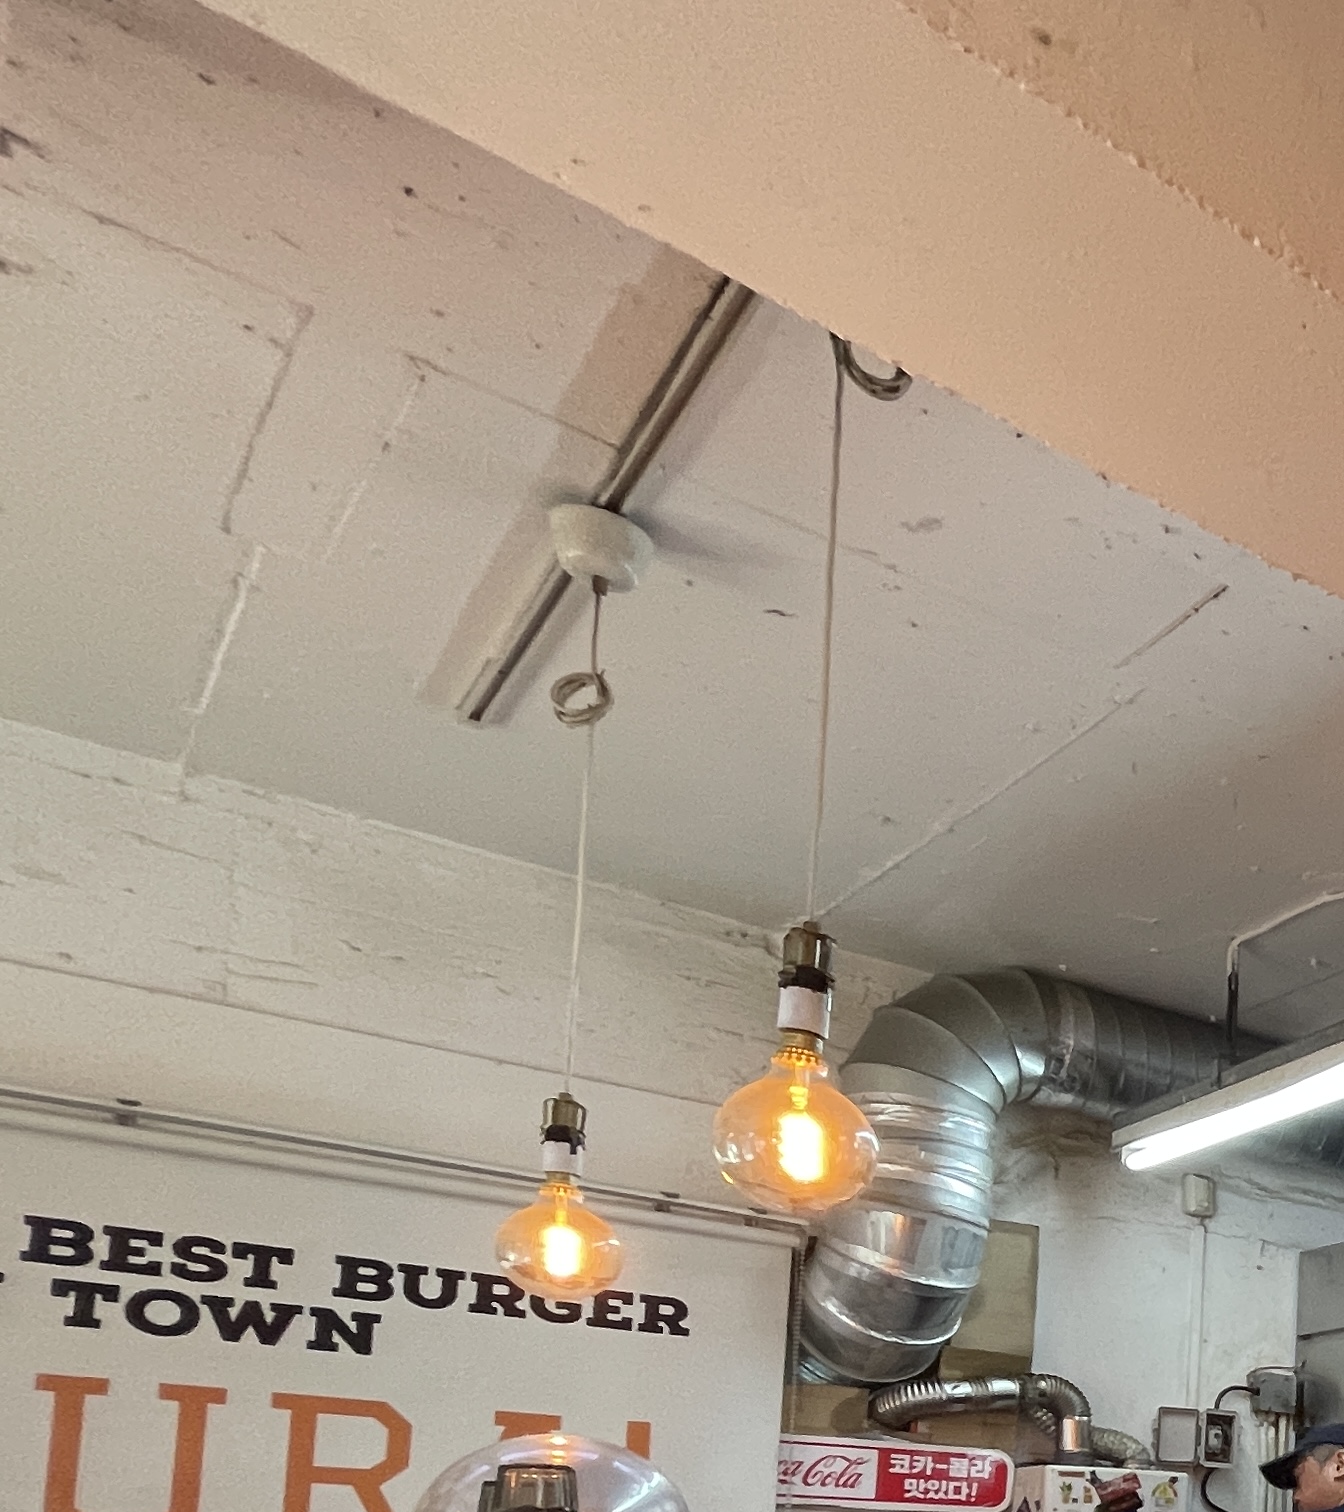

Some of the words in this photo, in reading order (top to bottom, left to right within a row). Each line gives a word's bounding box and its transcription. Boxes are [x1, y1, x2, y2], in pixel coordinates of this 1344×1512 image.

[20, 1215, 294, 1290] BEST
[332, 1255, 691, 1338] BURGER
[50, 1278, 382, 1355] TOWN
[889, 1453, 993, 1480] 코카-콜라
[904, 1478, 978, 1502] 맛있다!
